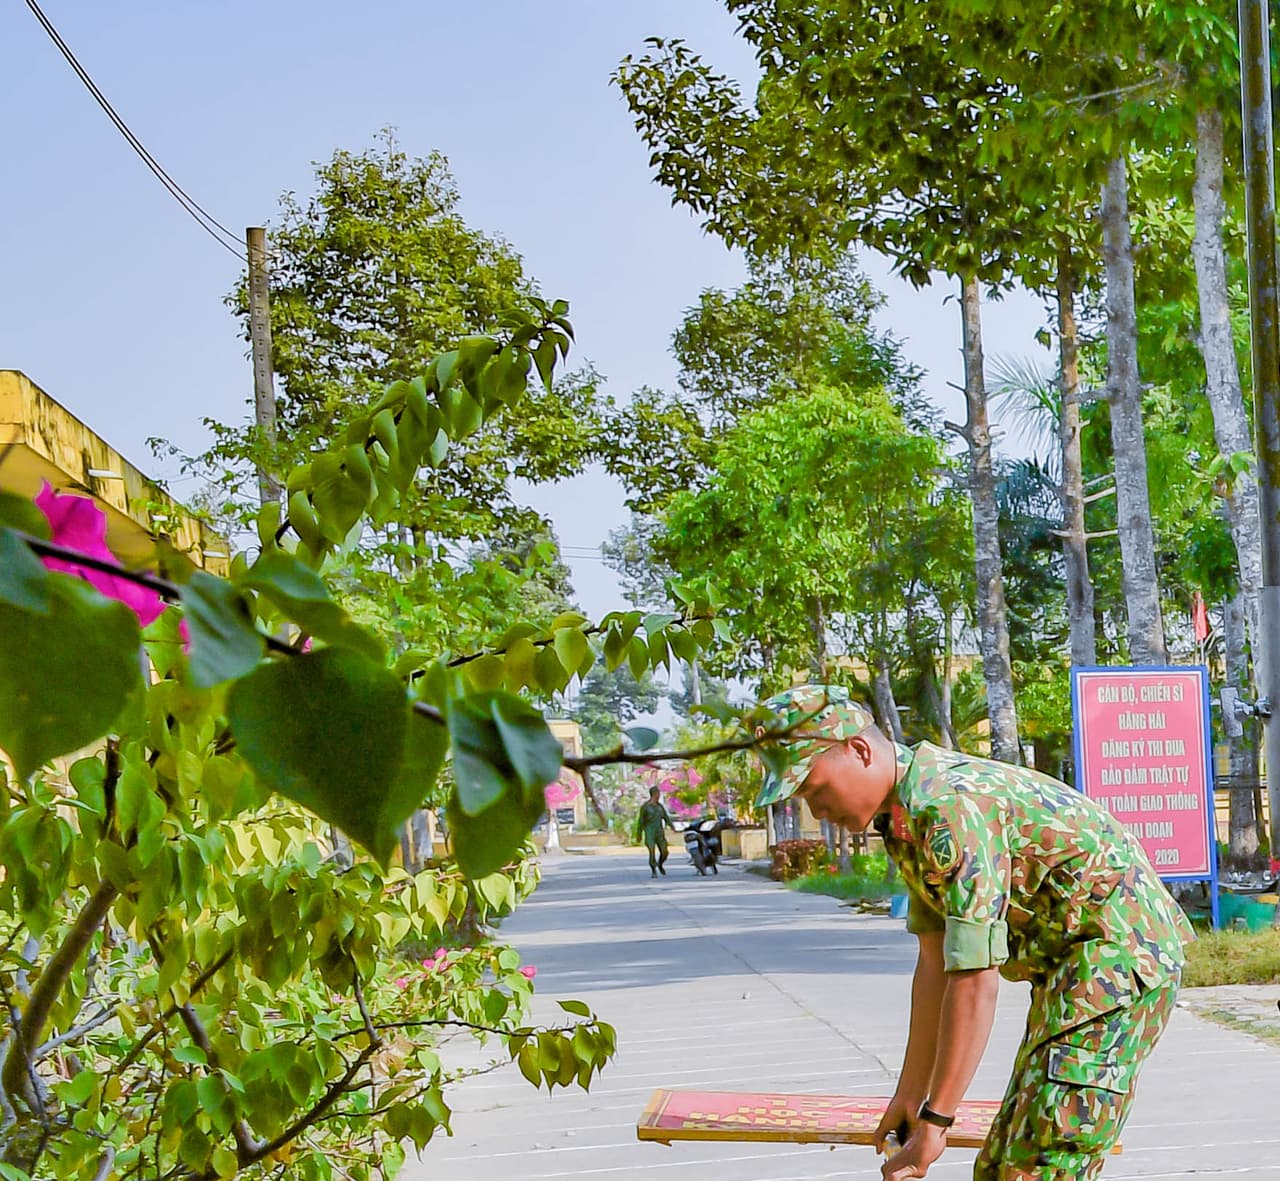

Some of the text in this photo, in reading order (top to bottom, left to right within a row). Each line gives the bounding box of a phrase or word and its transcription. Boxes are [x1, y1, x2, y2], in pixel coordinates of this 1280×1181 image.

[1098, 684, 1119, 703] CÁN
[1141, 682, 1170, 702] CHIẾN
[1148, 709, 1166, 730] HÁI
[1132, 737, 1145, 757] KÝ
[1147, 740, 1164, 757] THI
[1140, 795, 1164, 812] GIAO
[1155, 849, 1180, 865] 2020
